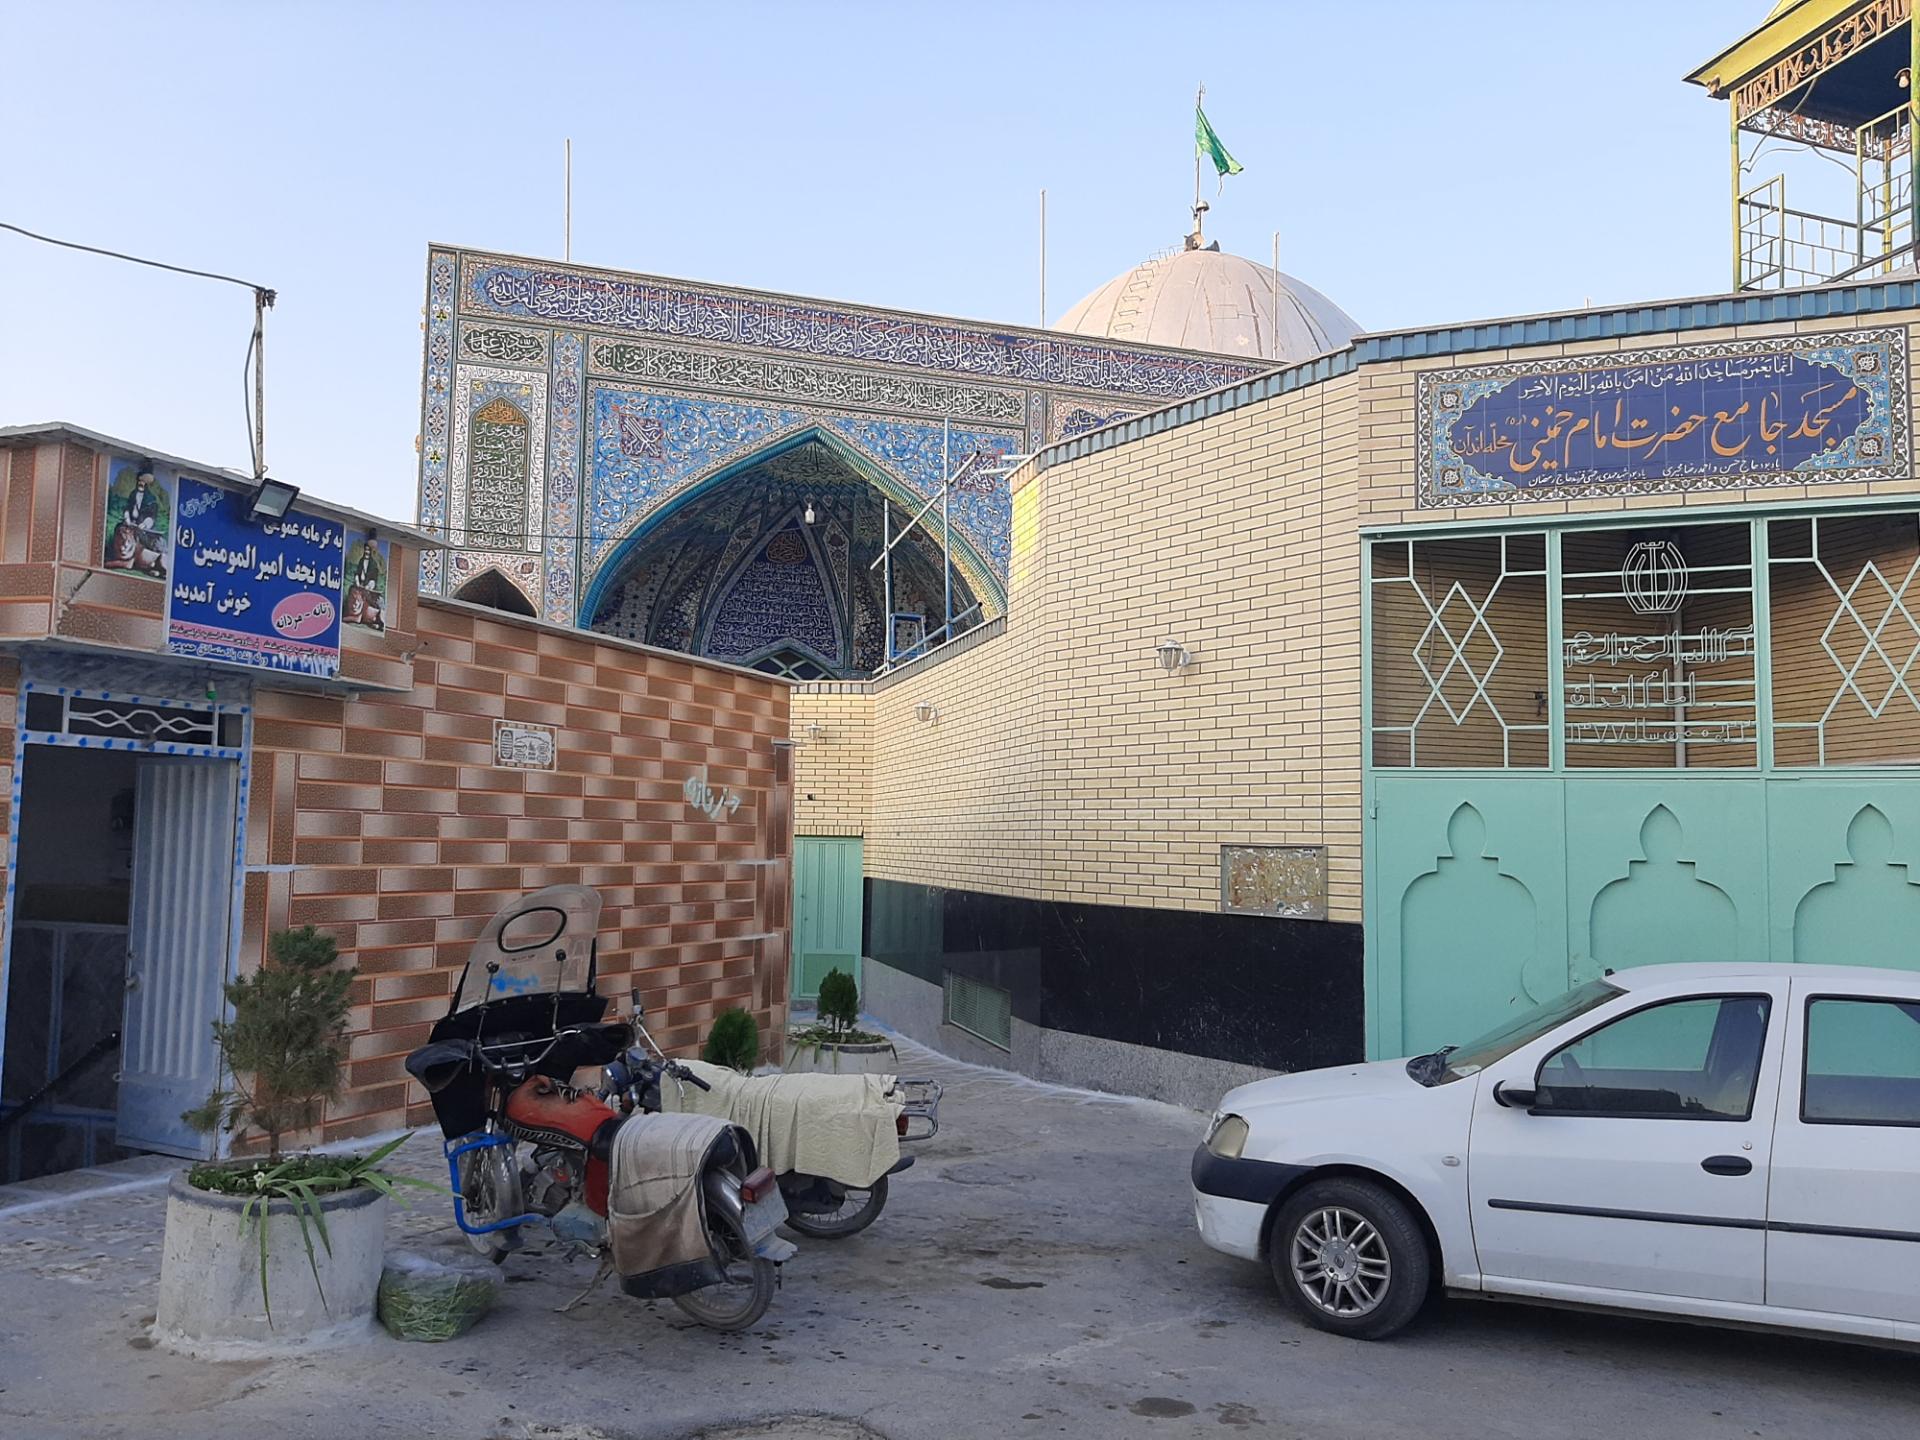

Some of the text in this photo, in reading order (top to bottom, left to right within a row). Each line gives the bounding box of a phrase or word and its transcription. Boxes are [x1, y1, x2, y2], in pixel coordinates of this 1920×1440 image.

[1612, 406, 1708, 459] حضرت
[1711, 392, 1788, 456] جامع
[1787, 383, 1857, 446] مسجد
[1510, 405, 1575, 472] خمینی
[1564, 398, 1622, 469] امام
[301, 523, 332, 549] گرمابه
[286, 557, 316, 590] نجف
[319, 565, 342, 590] شاه
[174, 581, 252, 616] خوش آمدید
[312, 602, 333, 619] زنانه
[275, 614, 303, 631] مردانه
[1643, 669, 1695, 709] امام
